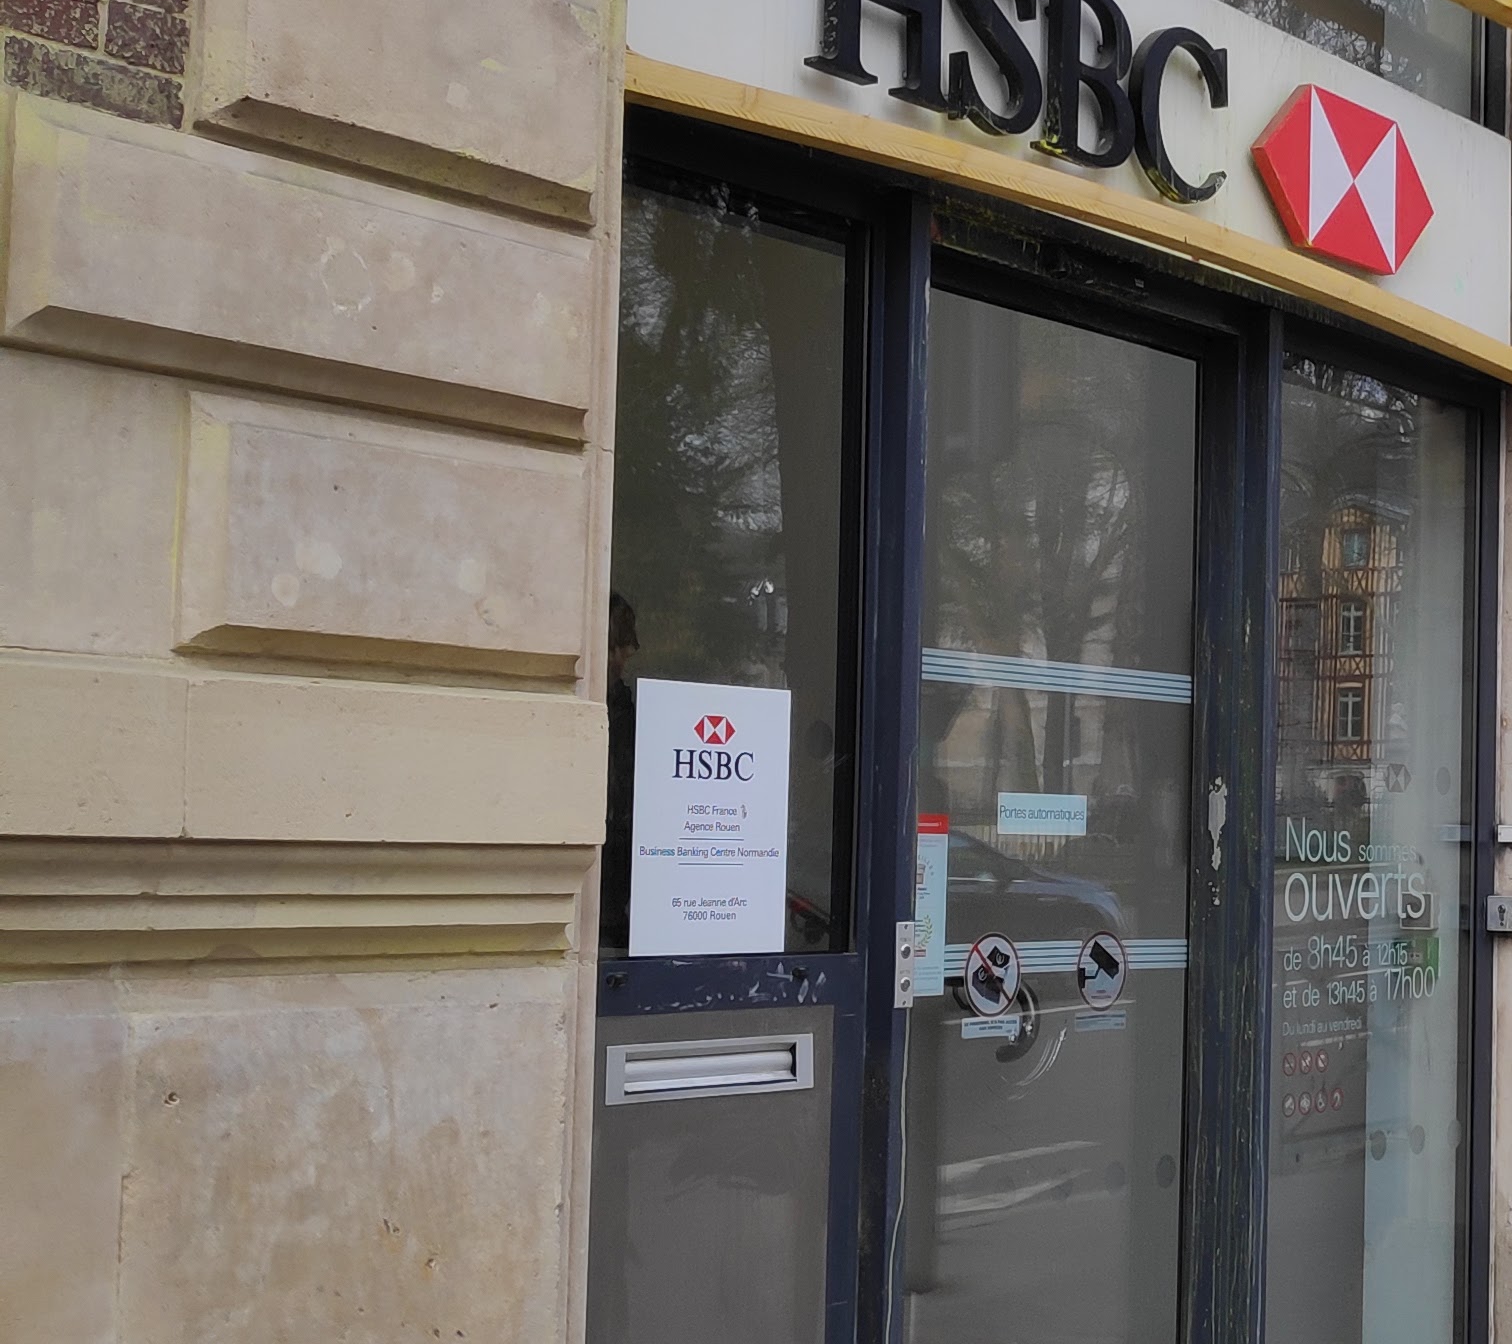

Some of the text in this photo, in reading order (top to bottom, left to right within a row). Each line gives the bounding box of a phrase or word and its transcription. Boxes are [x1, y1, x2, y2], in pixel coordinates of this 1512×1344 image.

[671, 748, 755, 782] HSBC
[687, 804, 738, 816] HSBC France
[999, 803, 1085, 823] Portes automatiques
[683, 820, 741, 833] Agence Rouen
[1284, 816, 1417, 863] Nous sommes
[639, 845, 780, 859] Business Banking Centre Normandie
[671, 896, 748, 908] 65 rue Jeanne d'Arc
[1284, 862, 1426, 922] ouverts
[682, 910, 737, 921] 76000 Rouen
[1283, 934, 1408, 972] de 8h45 à 12h15
[1283, 965, 1436, 1009] et de 13h45 à 17h00
[1282, 1015, 1363, 1037] Du lundi au vendredi
